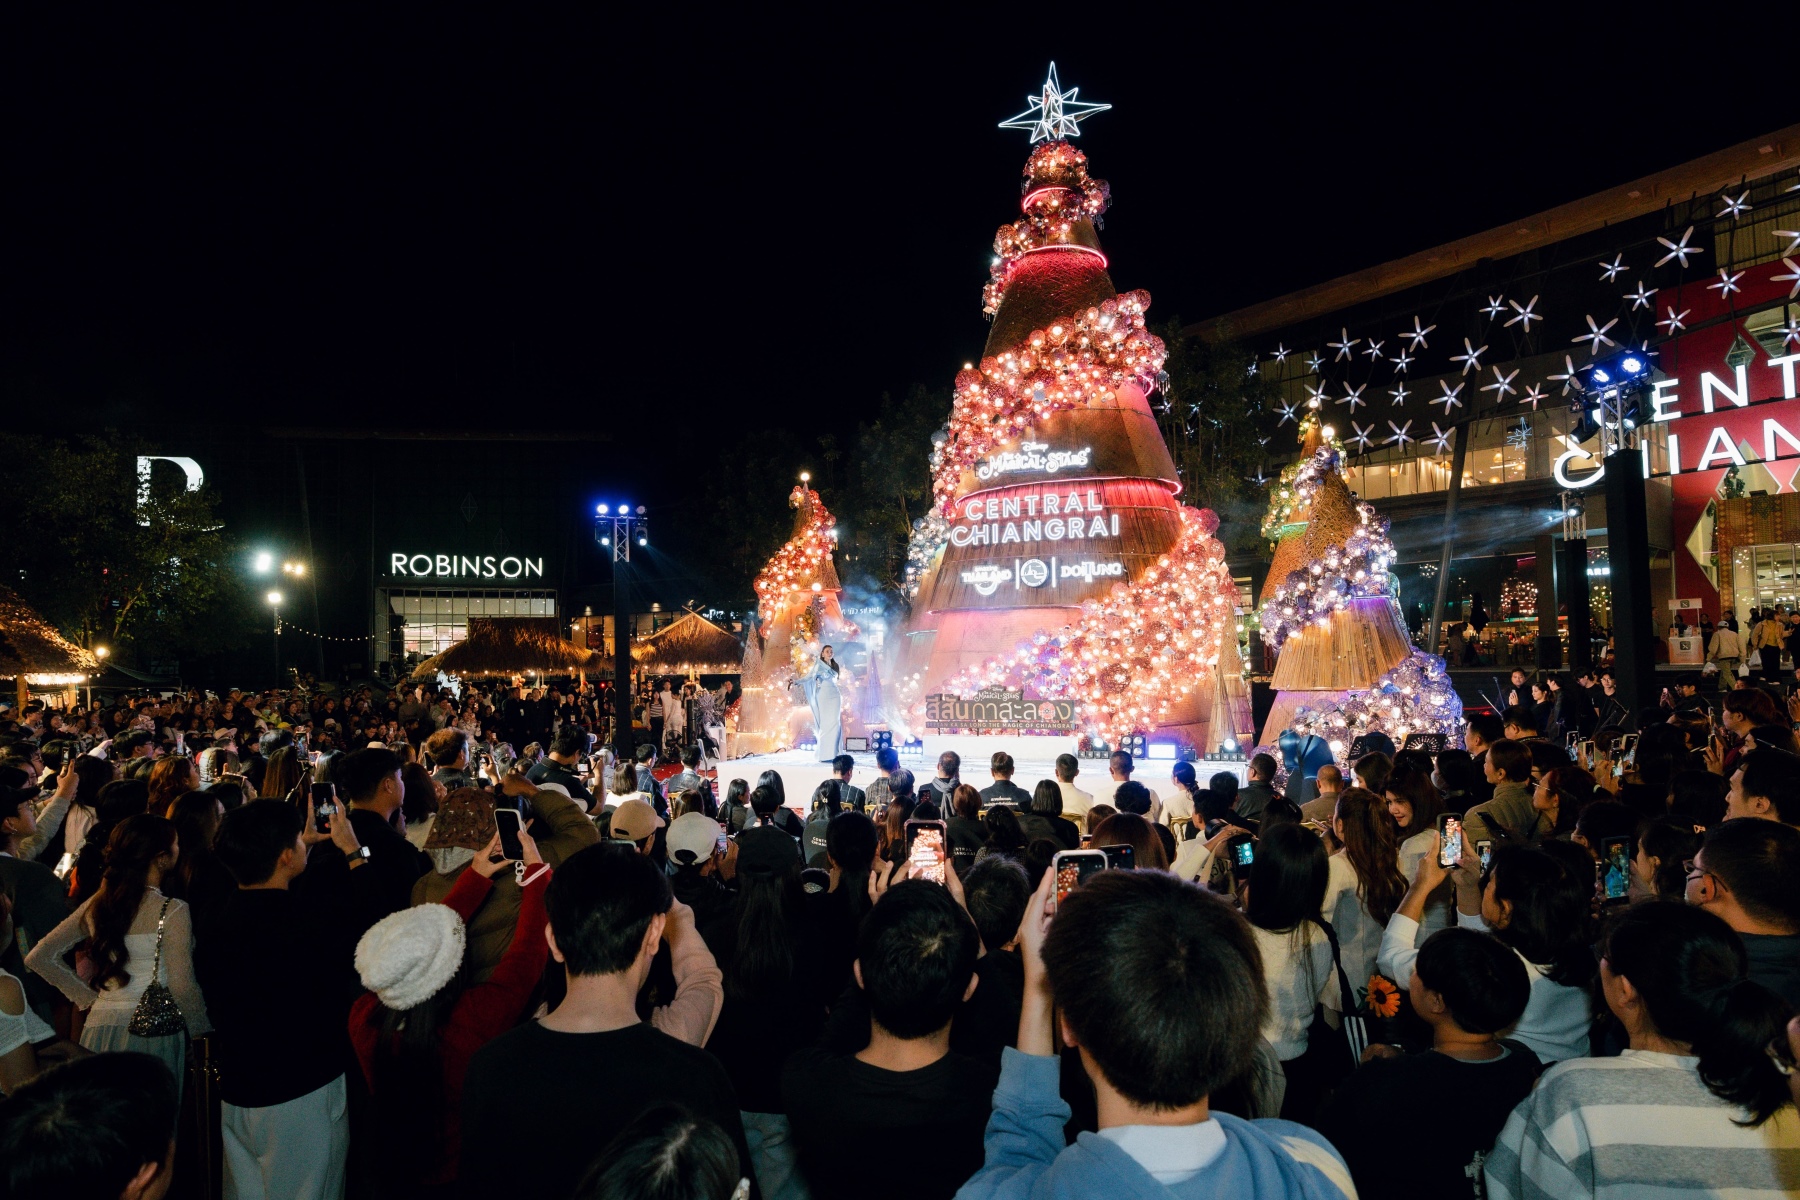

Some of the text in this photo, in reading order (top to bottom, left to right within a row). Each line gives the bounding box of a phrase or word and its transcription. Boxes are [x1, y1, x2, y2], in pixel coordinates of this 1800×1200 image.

[965, 490, 1103, 521] CENTRAL
[951, 514, 1120, 547] CHIANGRAI
[391, 553, 543, 578] ROBINSON
